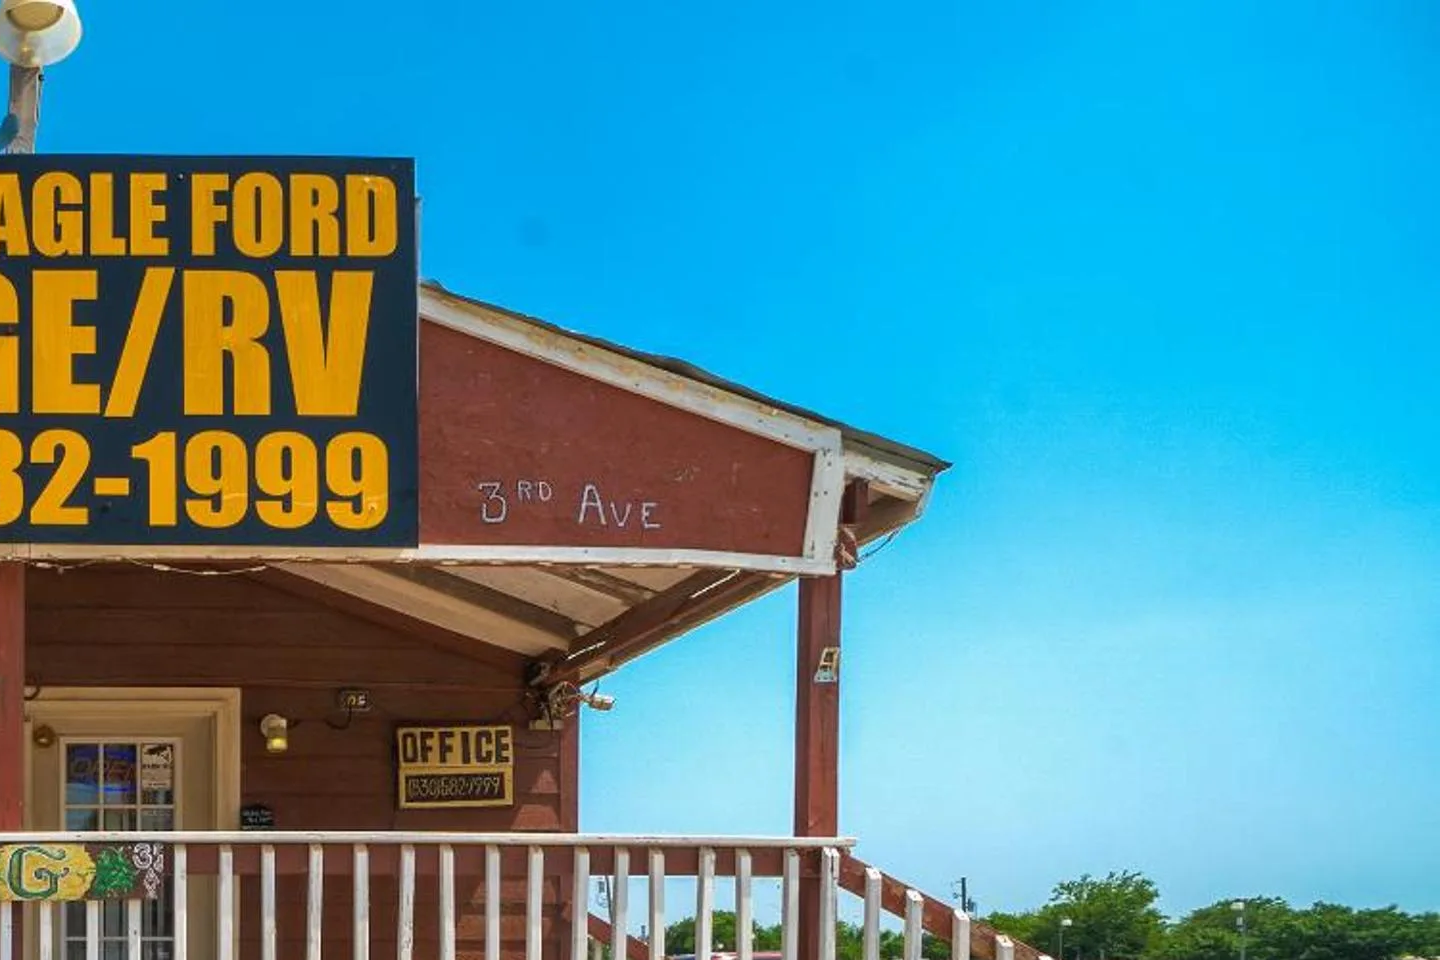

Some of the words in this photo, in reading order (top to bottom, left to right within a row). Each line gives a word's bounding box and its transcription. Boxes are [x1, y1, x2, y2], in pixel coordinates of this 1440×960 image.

[191, 172, 399, 260] FORD
[402, 729, 510, 765] OFFICE
[7, 846, 70, 900] G
